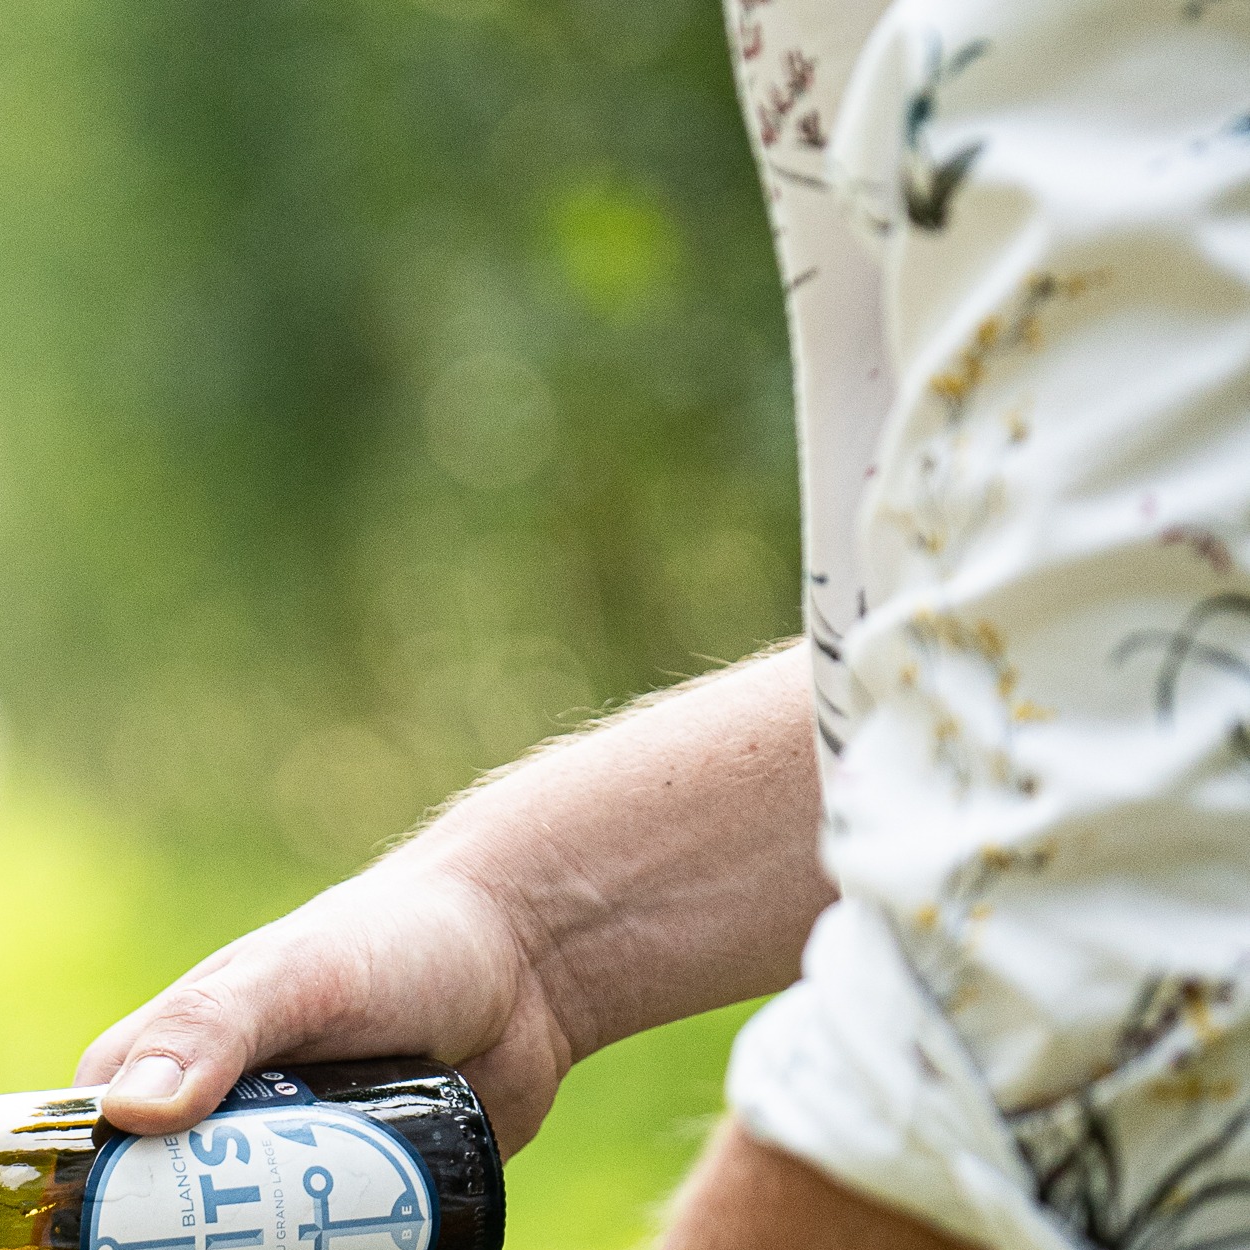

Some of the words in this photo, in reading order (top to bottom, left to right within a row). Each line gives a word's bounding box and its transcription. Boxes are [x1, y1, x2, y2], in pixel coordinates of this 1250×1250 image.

[163, 1136, 196, 1228] BLANCHE
[262, 1139, 282, 1184] LARGE
[273, 1188, 287, 1240] GRAND
